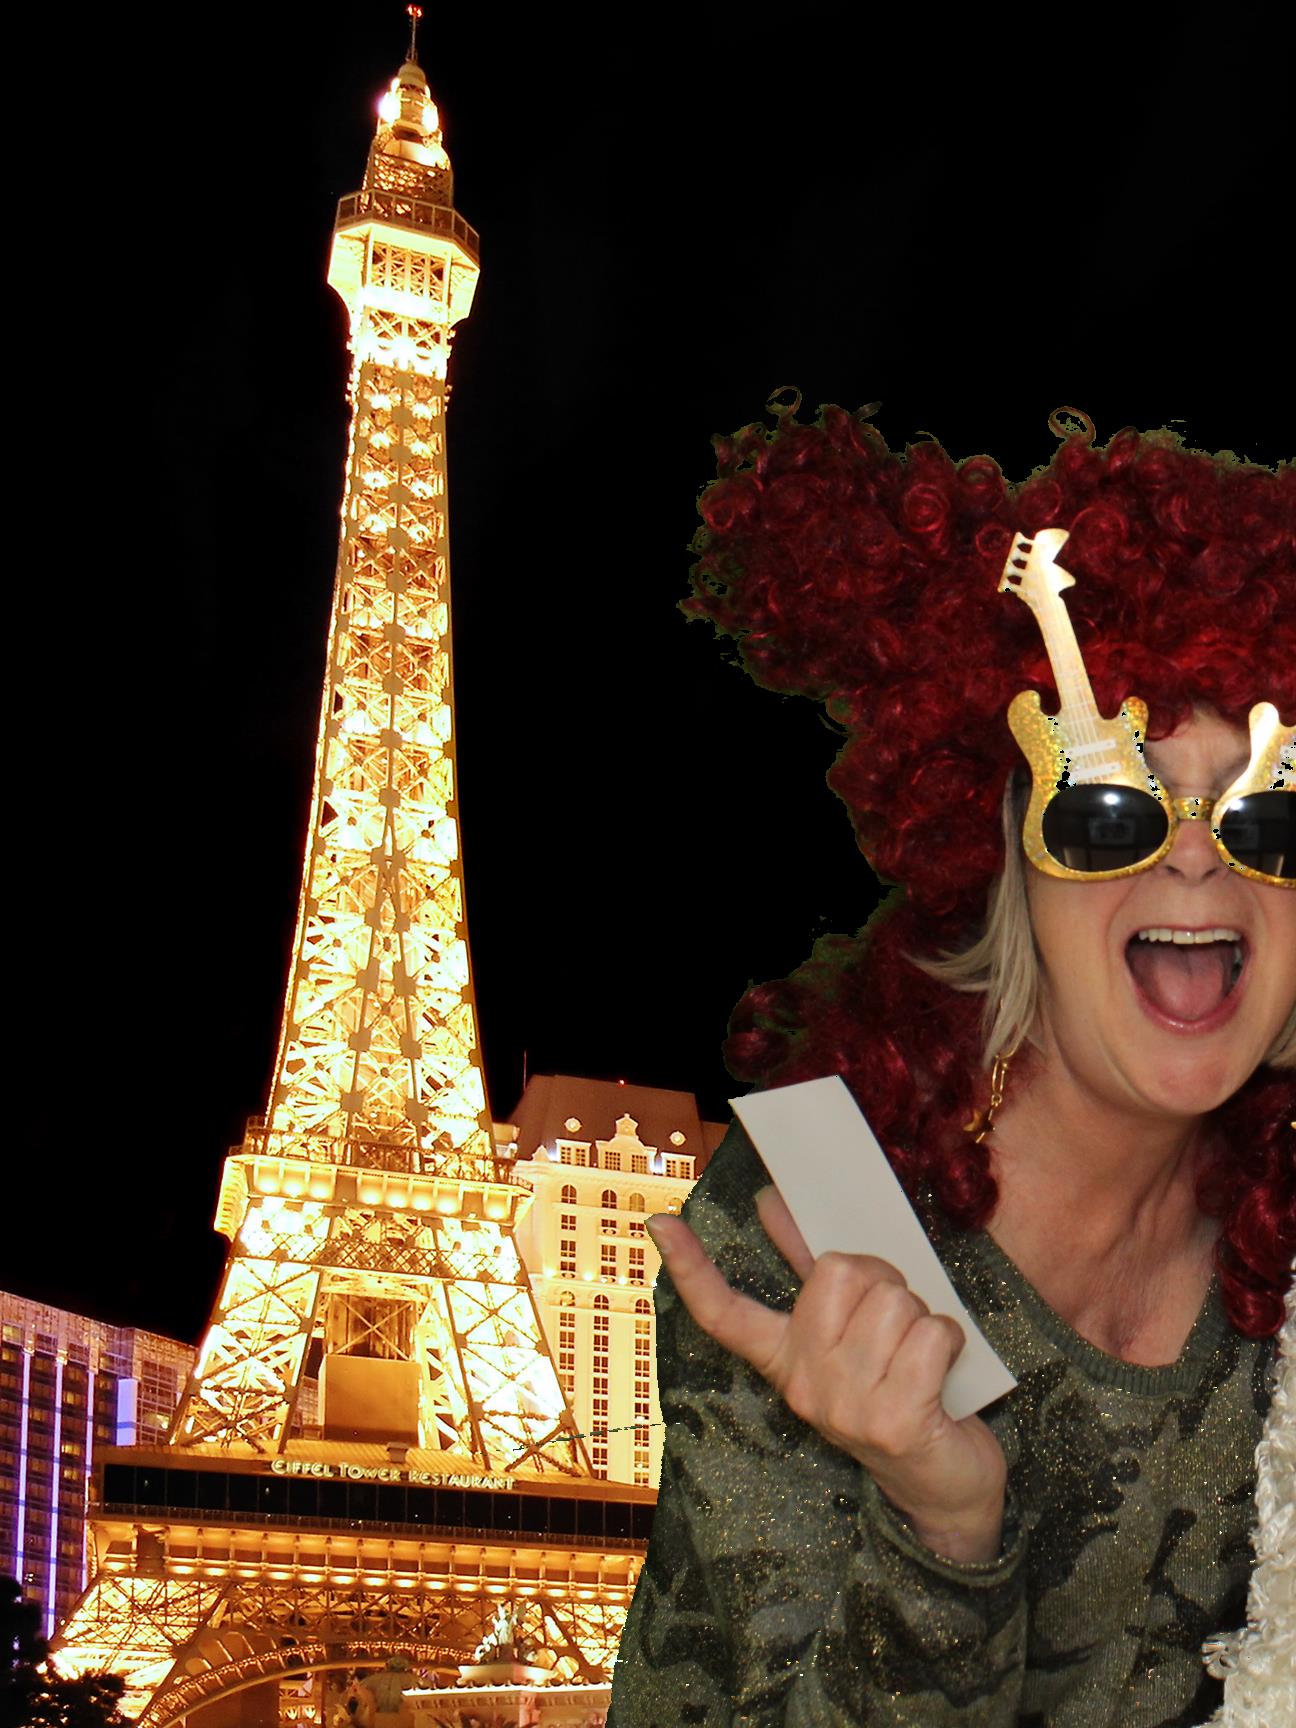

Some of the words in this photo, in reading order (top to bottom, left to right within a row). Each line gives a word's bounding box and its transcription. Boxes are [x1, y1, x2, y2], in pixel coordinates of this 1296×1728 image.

[271, 1458, 333, 1477] EIFFEL
[338, 1462, 401, 1481] TOWER
[408, 1470, 515, 1490] RESTAURANT
